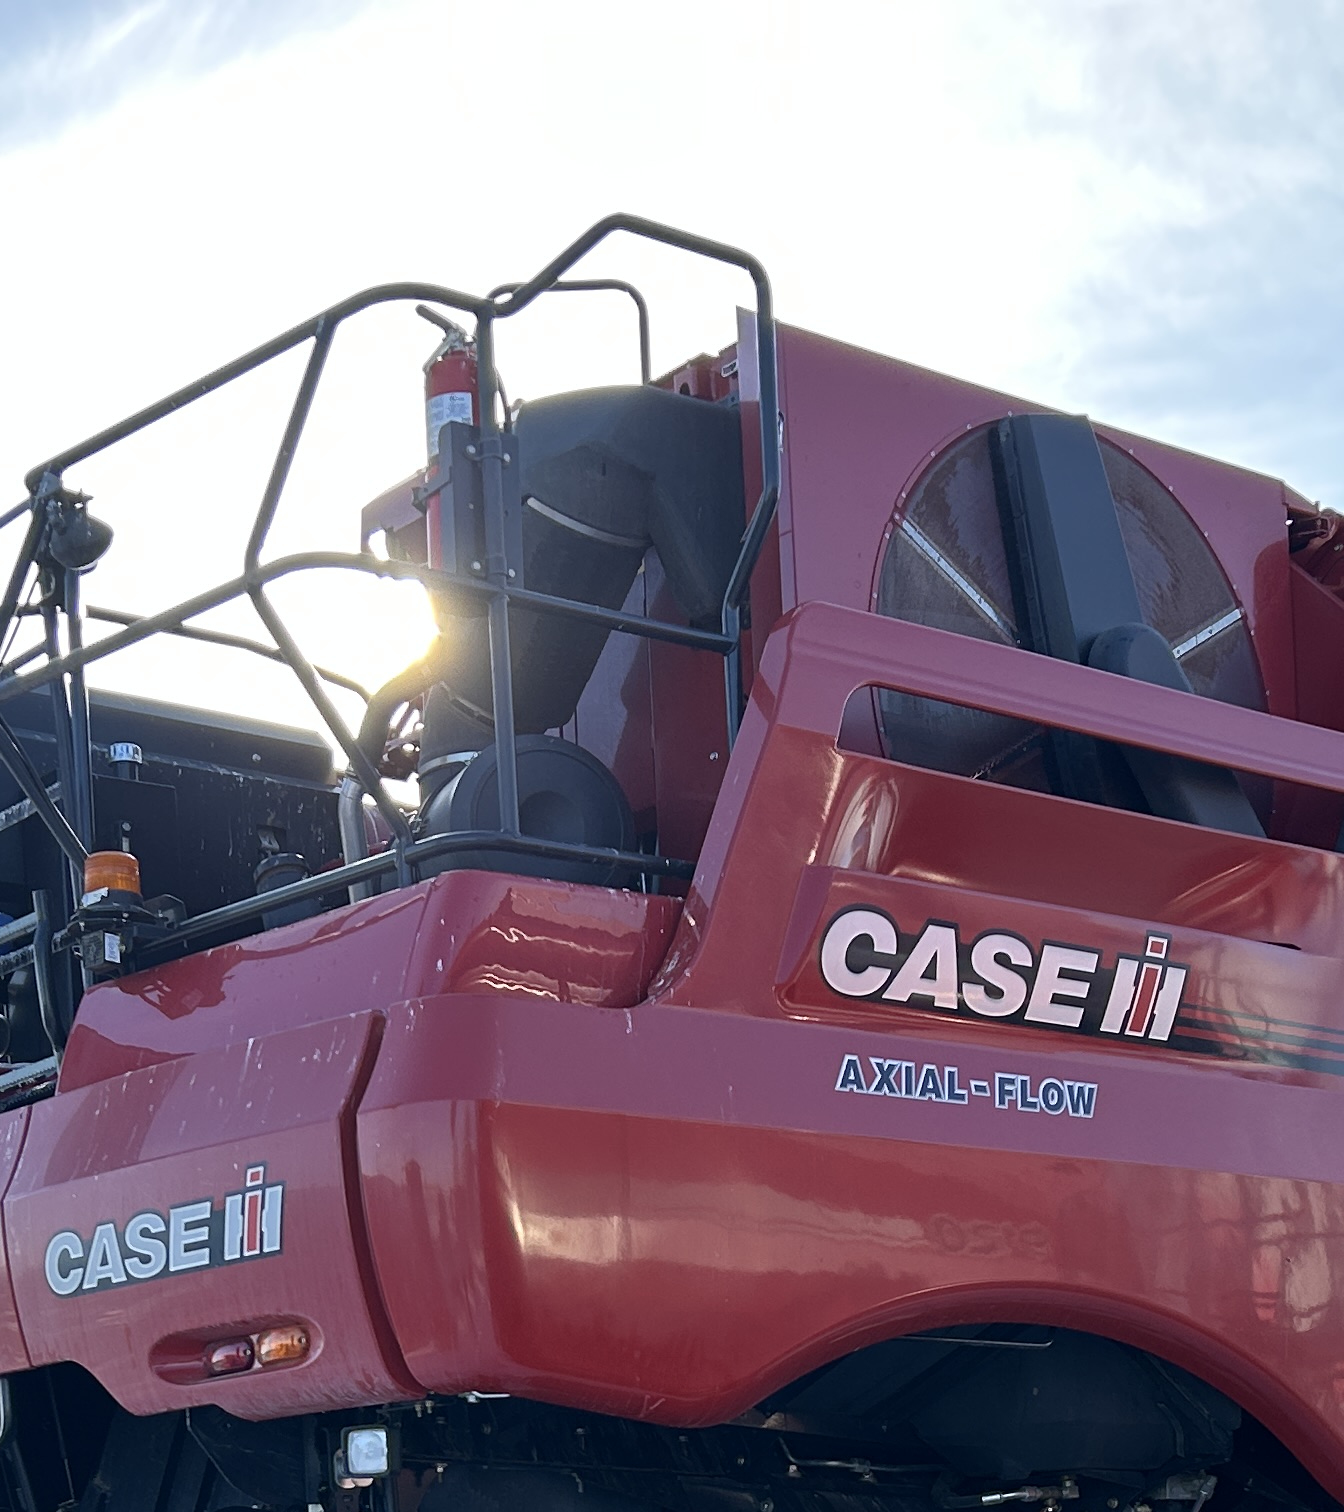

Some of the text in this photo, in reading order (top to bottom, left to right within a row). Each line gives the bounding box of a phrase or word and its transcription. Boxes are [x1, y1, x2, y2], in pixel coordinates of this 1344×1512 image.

[820, 908, 1100, 1028] CASE
[834, 1053, 1099, 1119] AXIAL-FLOW
[44, 1200, 212, 1296] CASE
